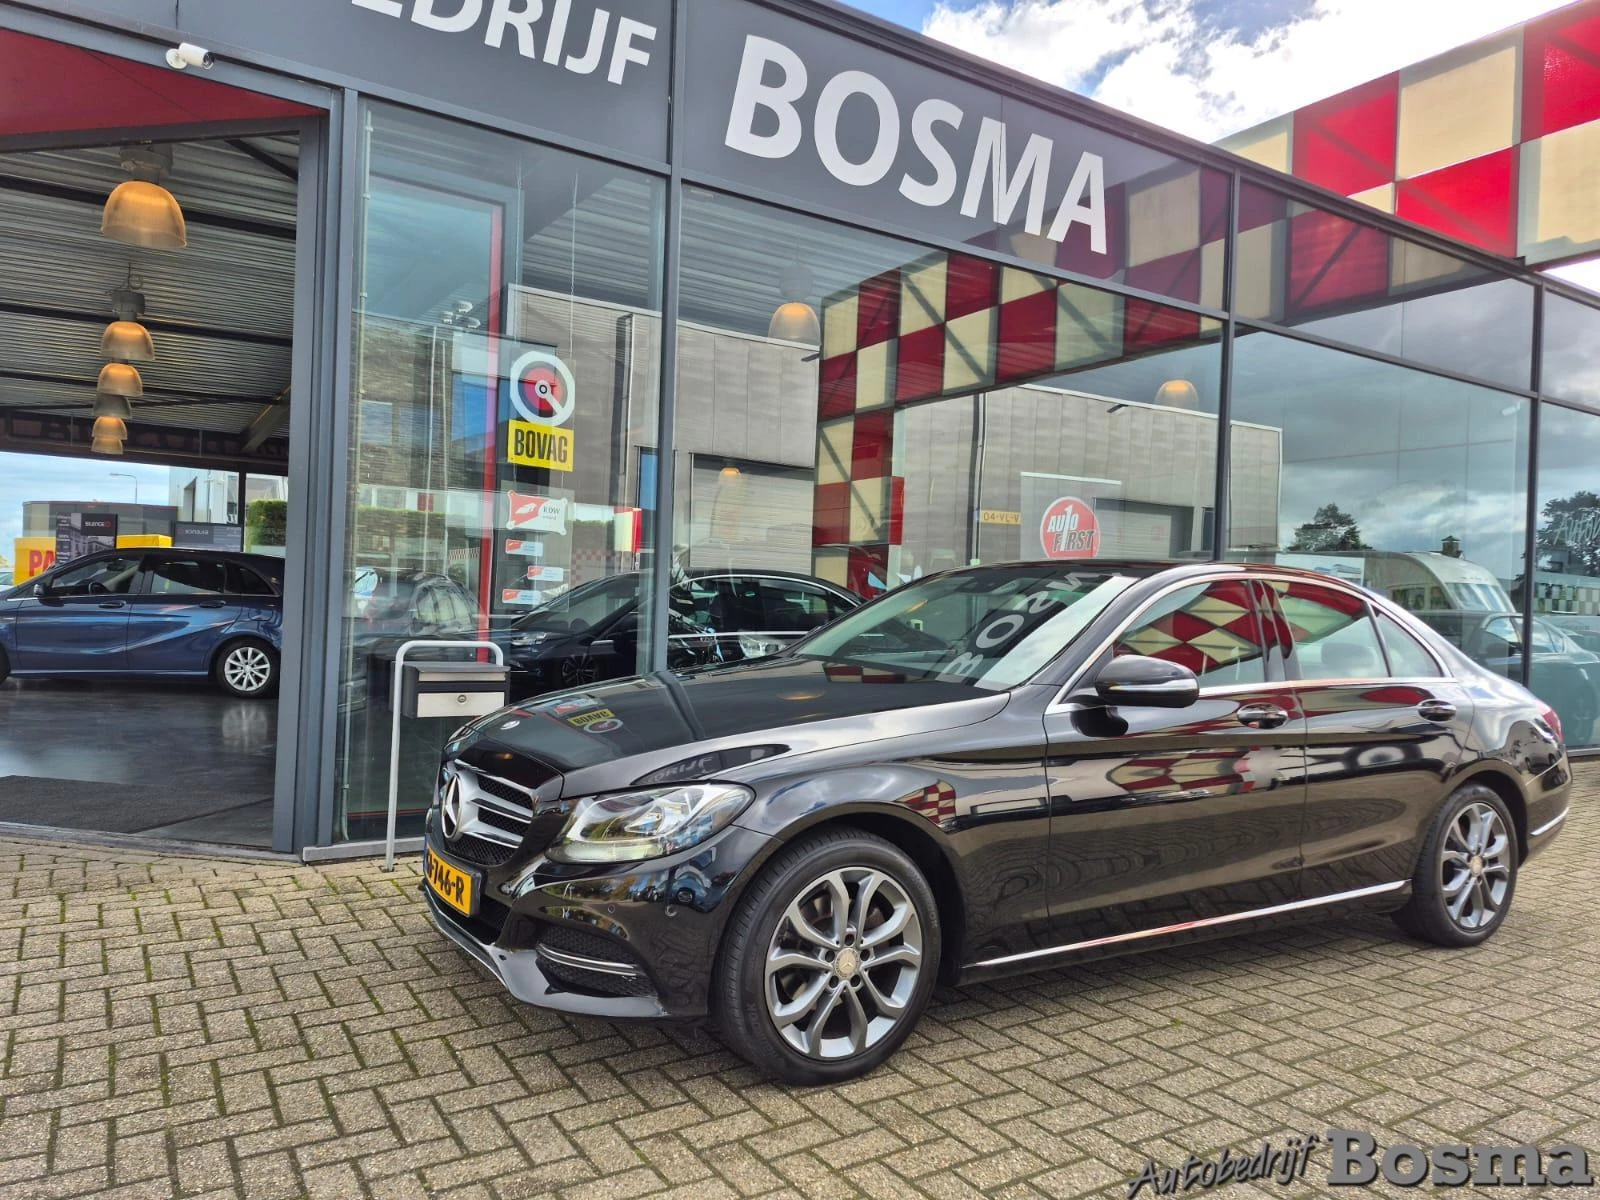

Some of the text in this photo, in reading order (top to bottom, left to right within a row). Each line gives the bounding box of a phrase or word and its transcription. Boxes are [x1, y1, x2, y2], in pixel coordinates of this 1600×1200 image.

[353, 0, 1107, 255] RIJF BOSMA
[514, 429, 568, 463] BOVAG
